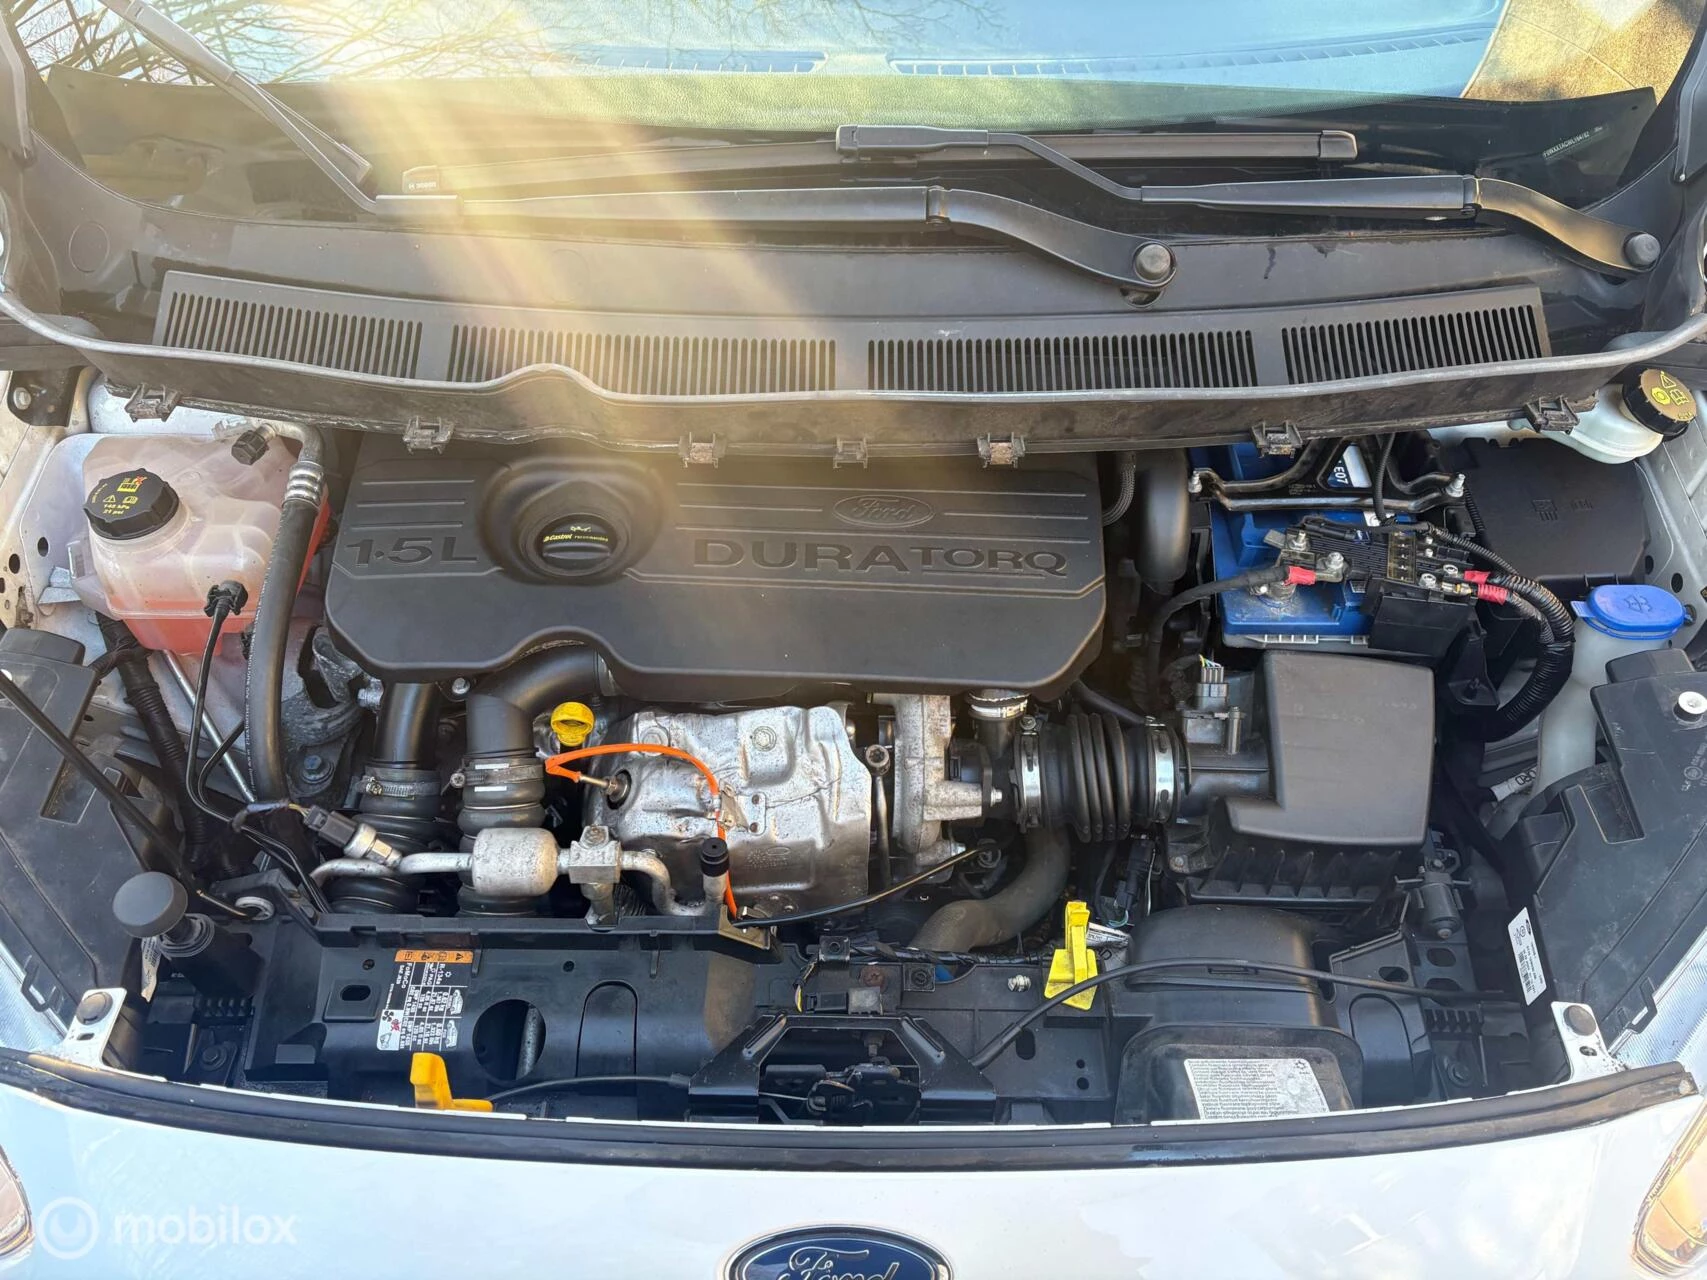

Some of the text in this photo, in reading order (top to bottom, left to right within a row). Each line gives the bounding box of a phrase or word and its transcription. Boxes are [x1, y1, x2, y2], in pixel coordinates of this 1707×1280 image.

[851, 497, 917, 521] Ford
[693, 538, 1068, 579] DURATORQ
[401, 962, 412, 989] FoMoCo
